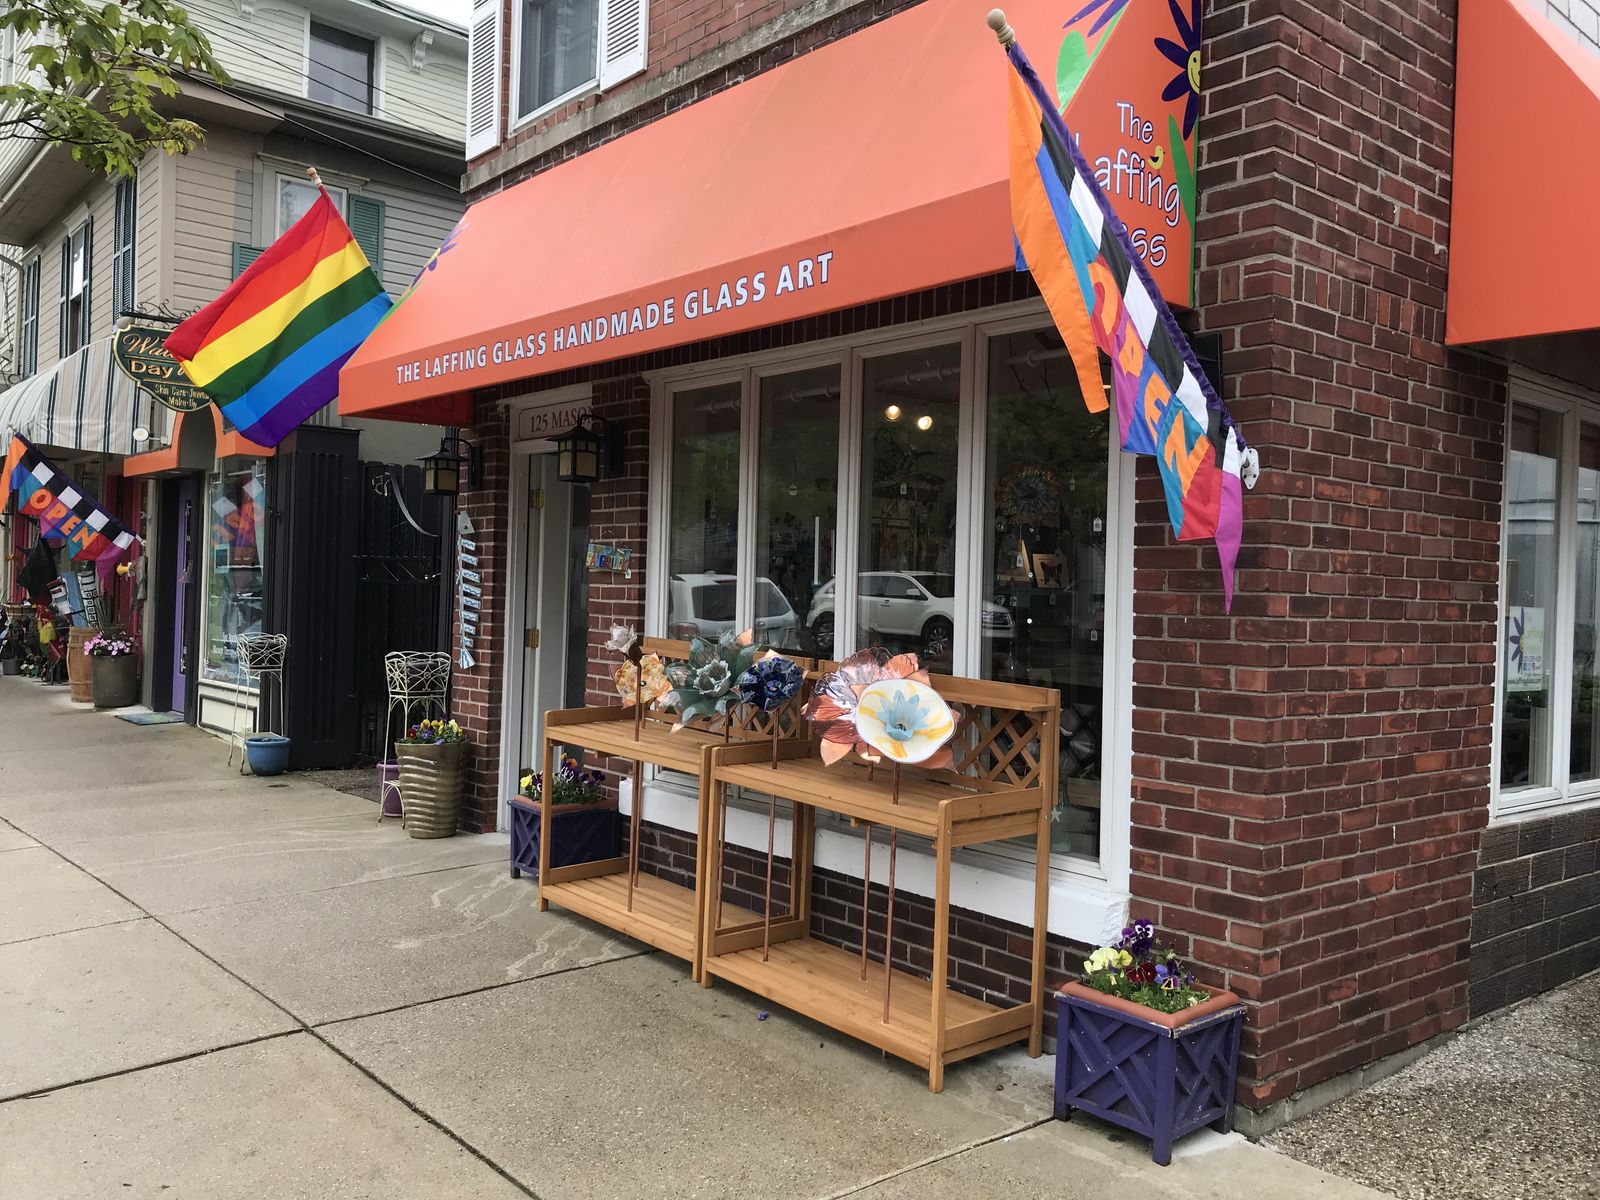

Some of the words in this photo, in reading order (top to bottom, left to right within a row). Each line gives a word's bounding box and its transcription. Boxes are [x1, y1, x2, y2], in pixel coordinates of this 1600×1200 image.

[1116, 102, 1153, 143] The
[1074, 132, 1180, 227] affing
[396, 363, 421, 385] THE
[424, 345, 488, 379] LAFFING
[492, 331, 547, 365] GLASS
[553, 298, 675, 351] HANDMADE
[684, 272, 766, 319] GLASS
[776, 251, 833, 295] ART
[131, 360, 172, 378] Day
[531, 414, 548, 433] 125
[29, 488, 99, 550] OPEN
